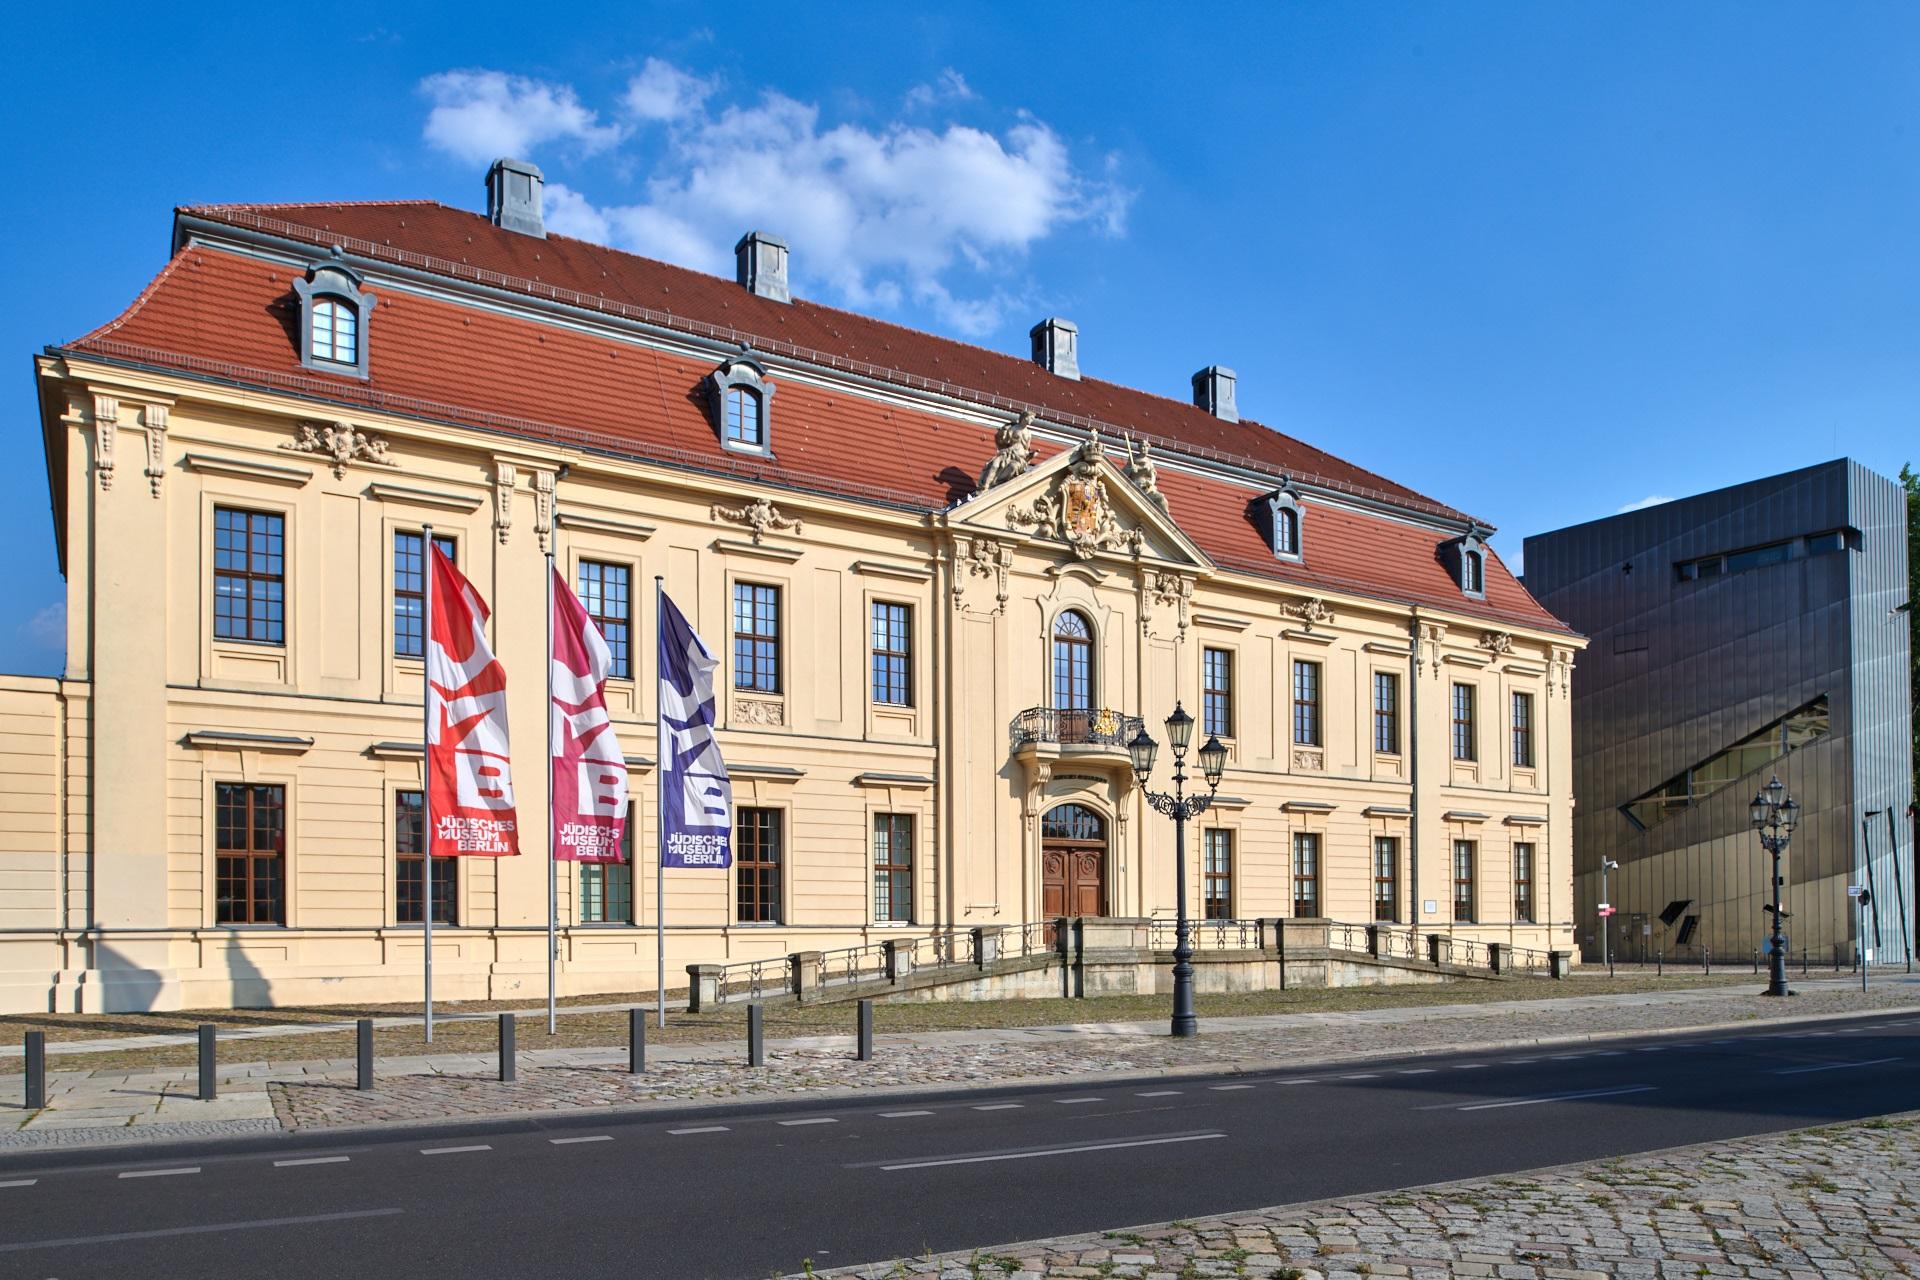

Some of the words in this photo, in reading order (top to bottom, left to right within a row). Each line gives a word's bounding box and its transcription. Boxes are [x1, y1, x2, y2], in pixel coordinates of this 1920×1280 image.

[436, 814, 515, 832] JÜDISCHES
[438, 828, 500, 842] MUSEUM
[560, 834, 615, 847] MUSEUM
[457, 839, 509, 853] BERLIN
[576, 845, 616, 857] BERLI
[668, 844, 721, 855] MUSEUM
[683, 854, 724, 865] BERLIN
